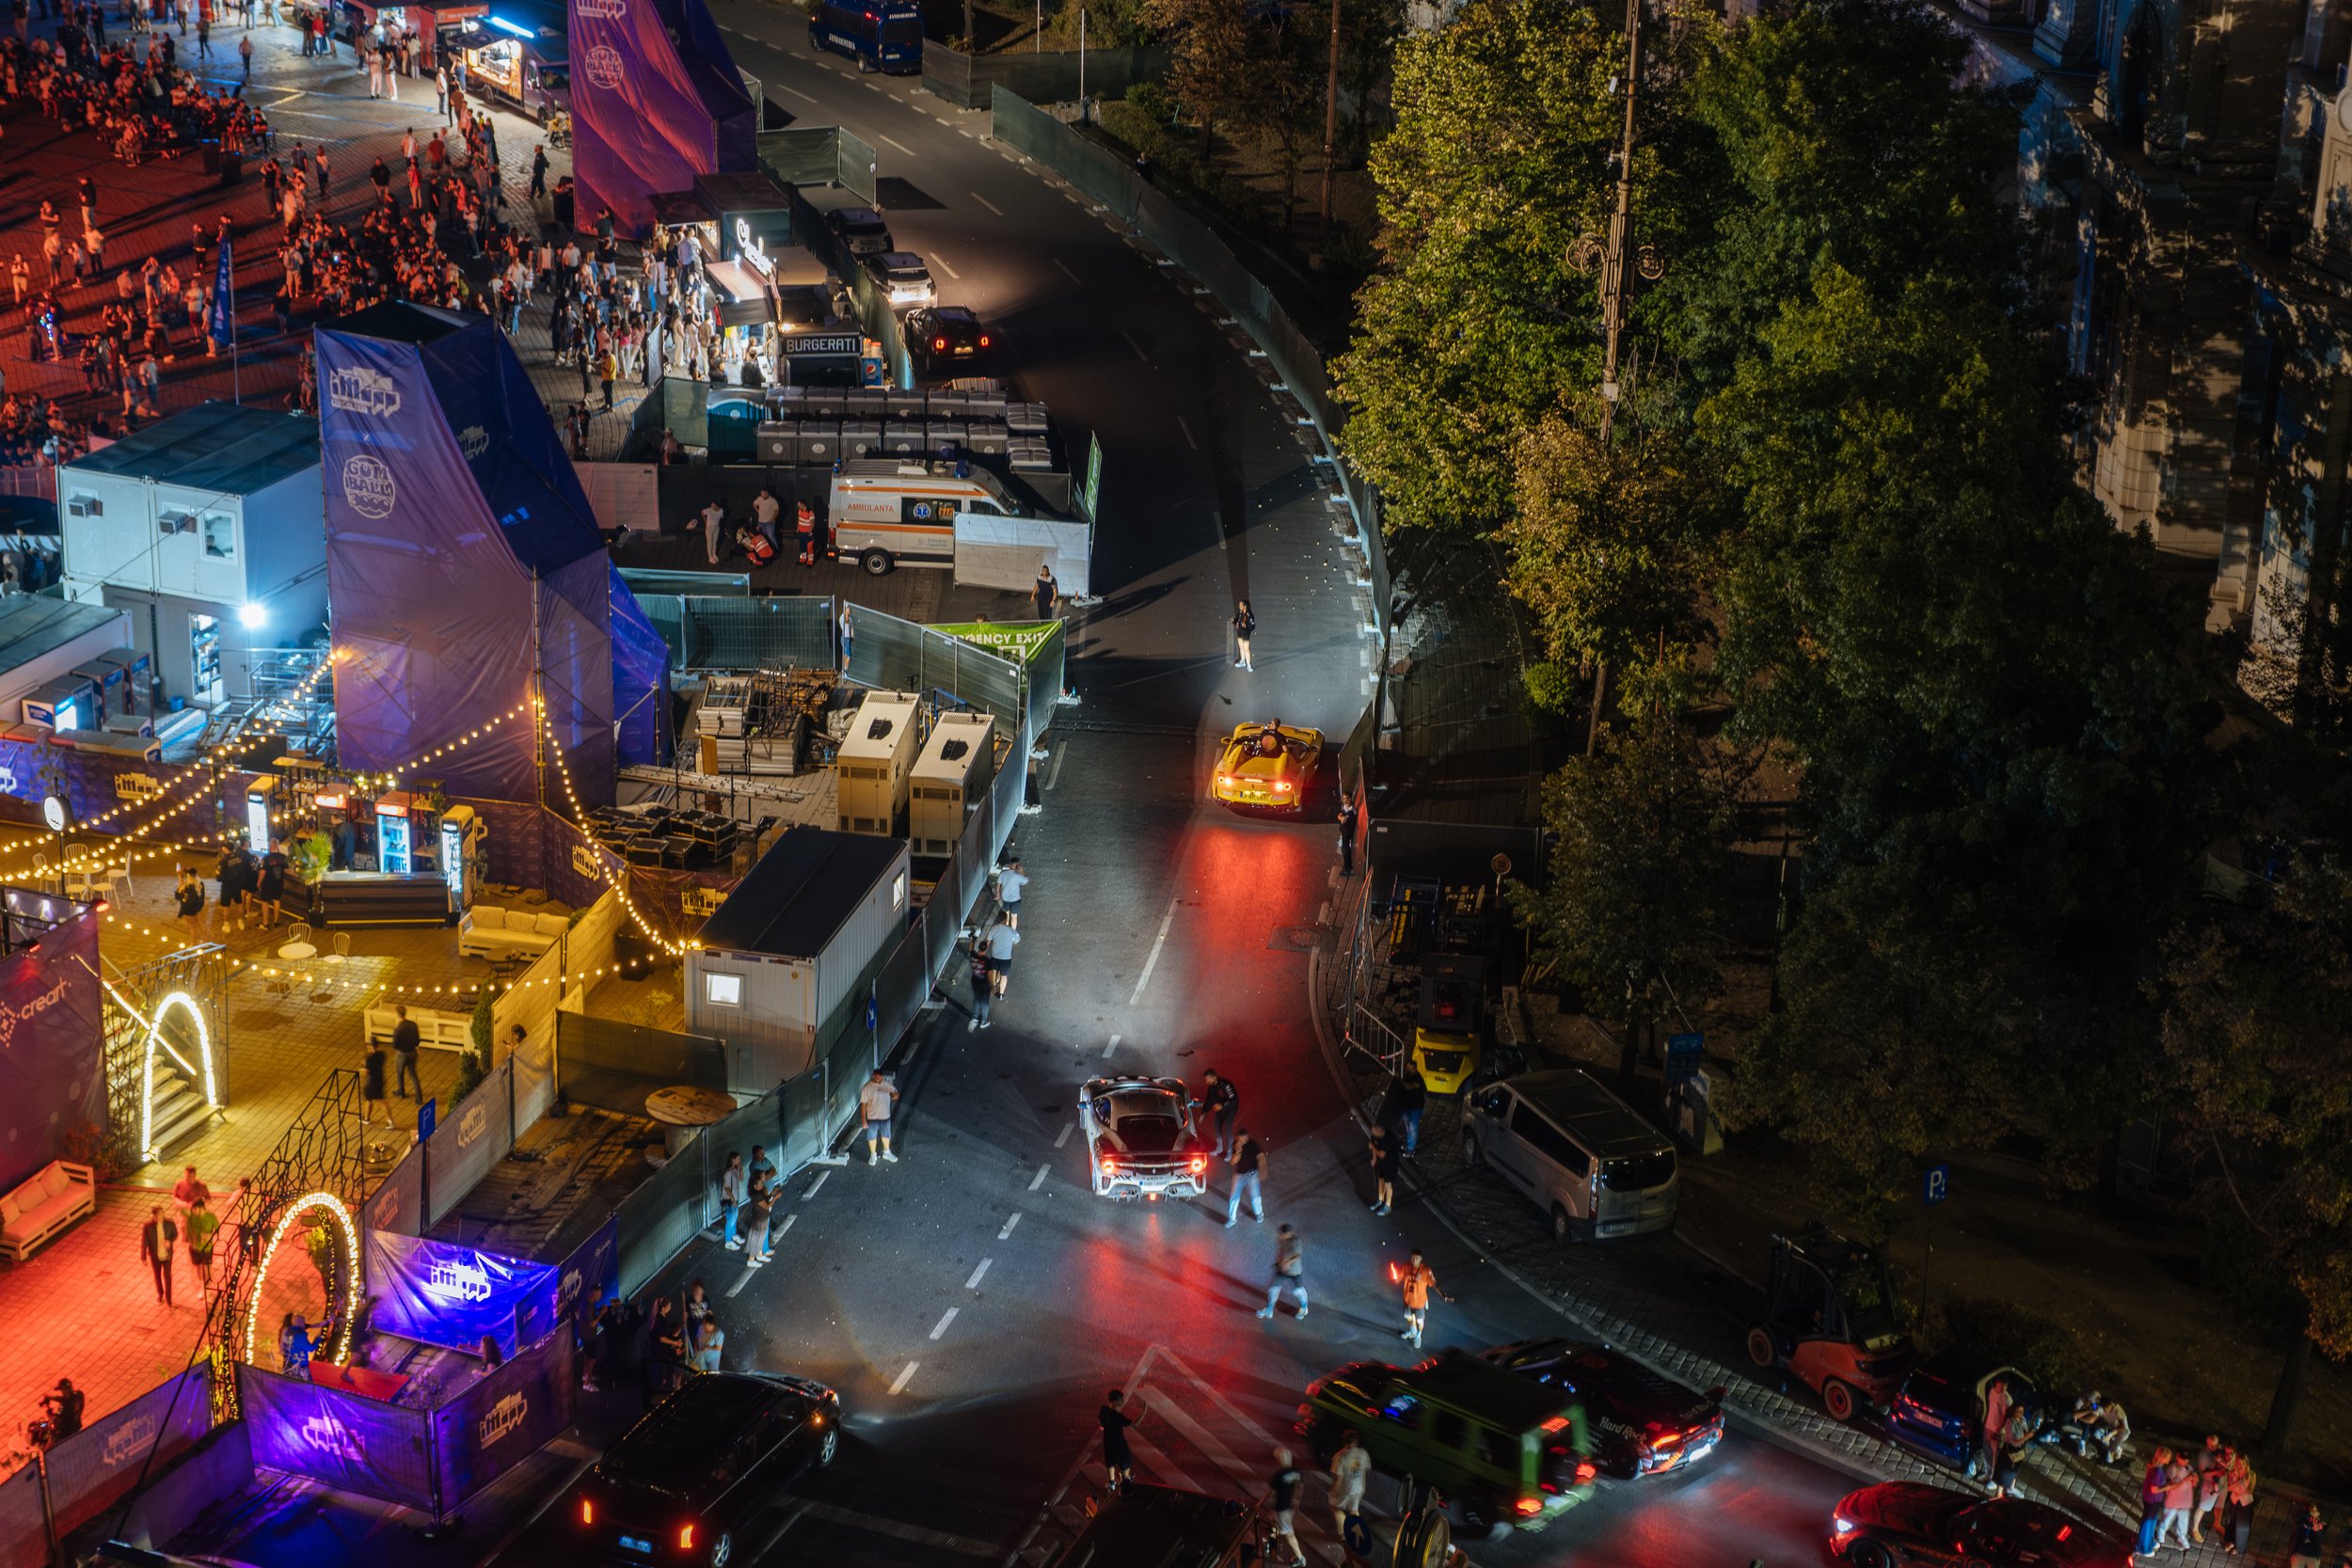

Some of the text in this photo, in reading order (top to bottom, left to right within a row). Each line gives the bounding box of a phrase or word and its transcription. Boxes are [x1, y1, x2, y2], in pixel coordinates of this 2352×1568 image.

[787, 339, 855, 352] BURGERATI
[347, 462, 389, 481] GUM
[1016, 632, 1043, 643] EXIT
[21, 976, 67, 1021] creart
[423, 1107, 432, 1129] P
[1930, 1169, 1943, 1198] P
[1599, 1416, 1646, 1443] Hard Rock
